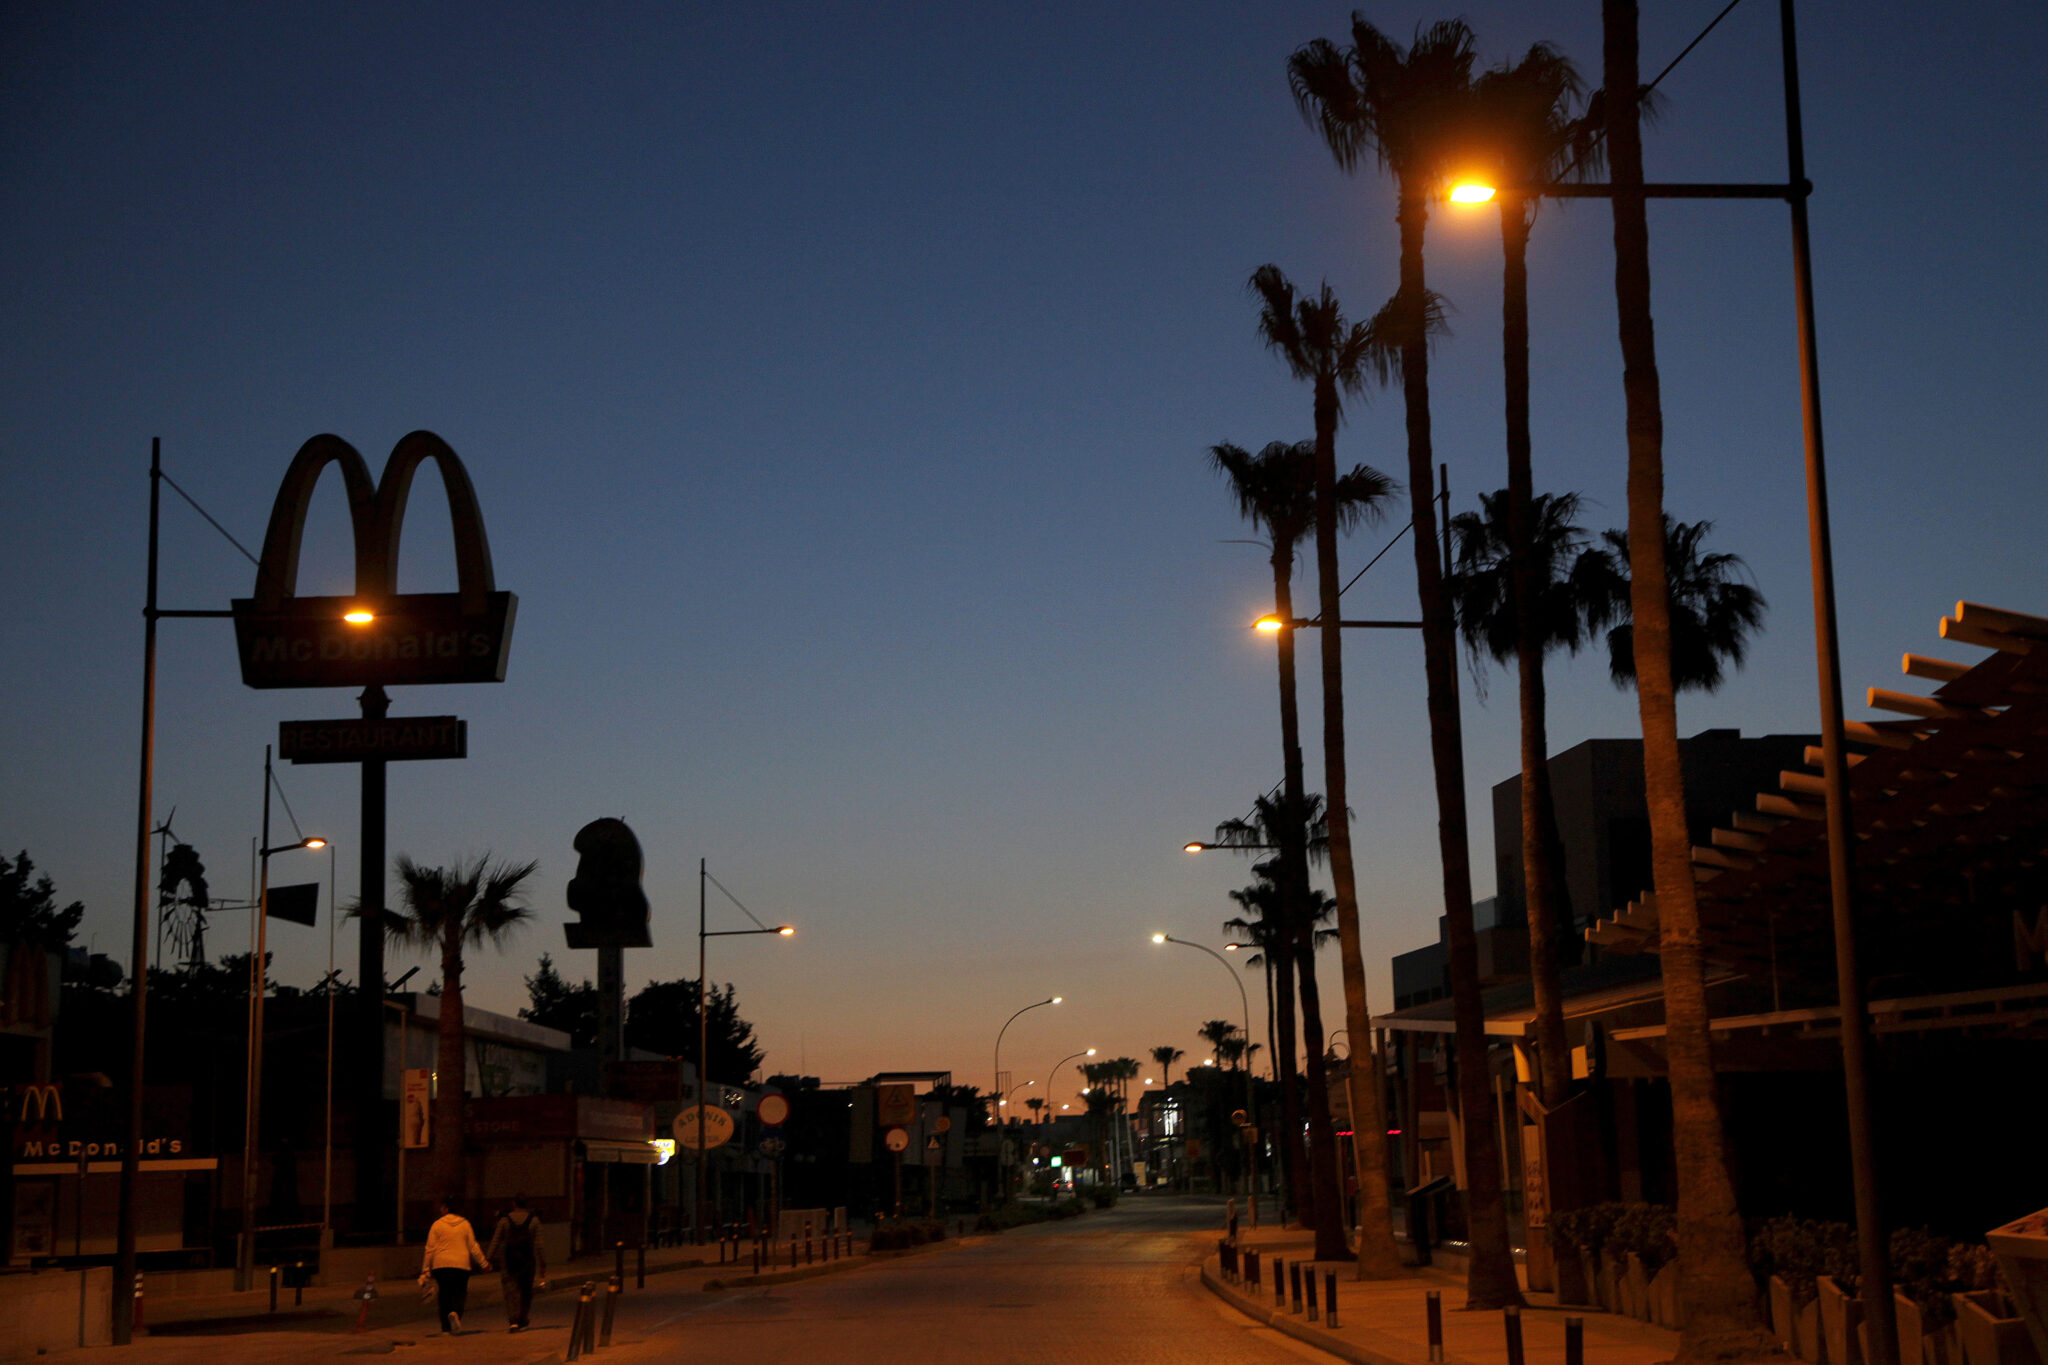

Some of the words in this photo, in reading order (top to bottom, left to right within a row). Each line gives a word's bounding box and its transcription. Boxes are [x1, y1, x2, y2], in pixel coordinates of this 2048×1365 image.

[251, 629, 491, 662] McDonald's
[282, 724, 450, 750] RESTAURANT
[23, 1137, 183, 1158] McDonld's
